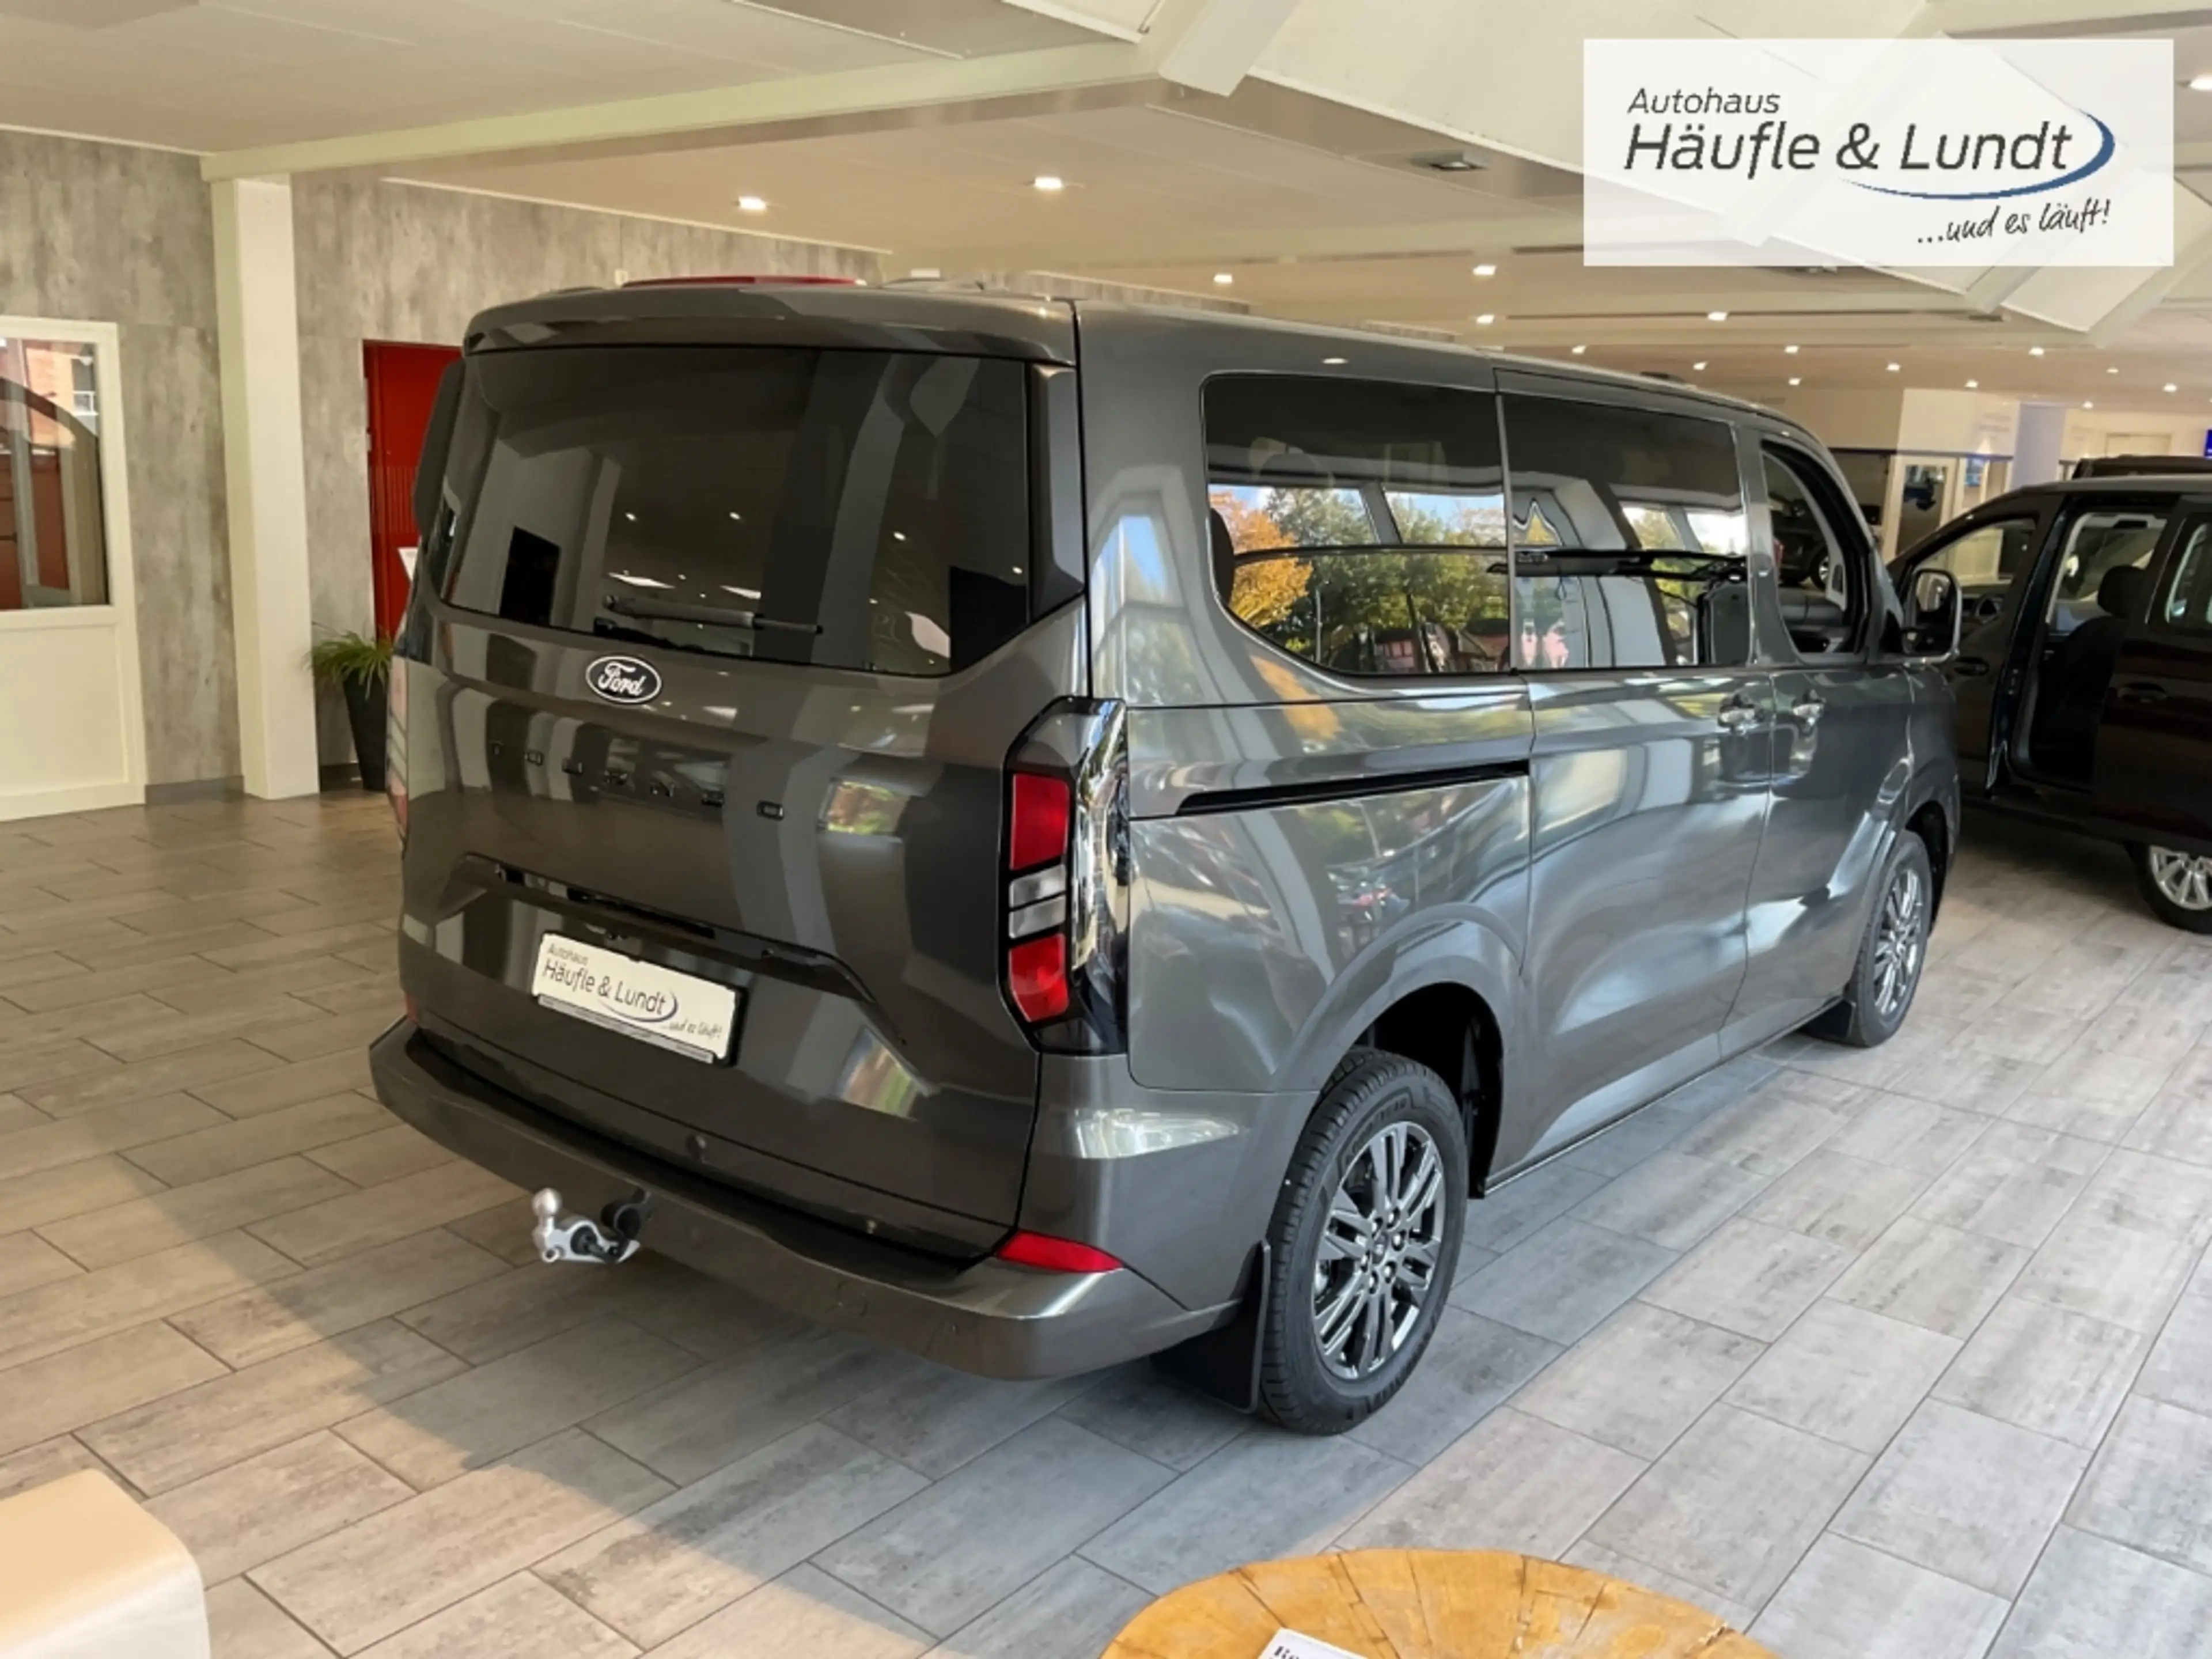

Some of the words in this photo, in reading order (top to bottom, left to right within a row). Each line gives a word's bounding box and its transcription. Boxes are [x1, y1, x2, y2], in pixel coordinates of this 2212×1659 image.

[597, 661, 646, 696] Ford
[541, 958, 596, 992] Häufle
[597, 975, 612, 999] &
[614, 980, 666, 1016] Lundt
